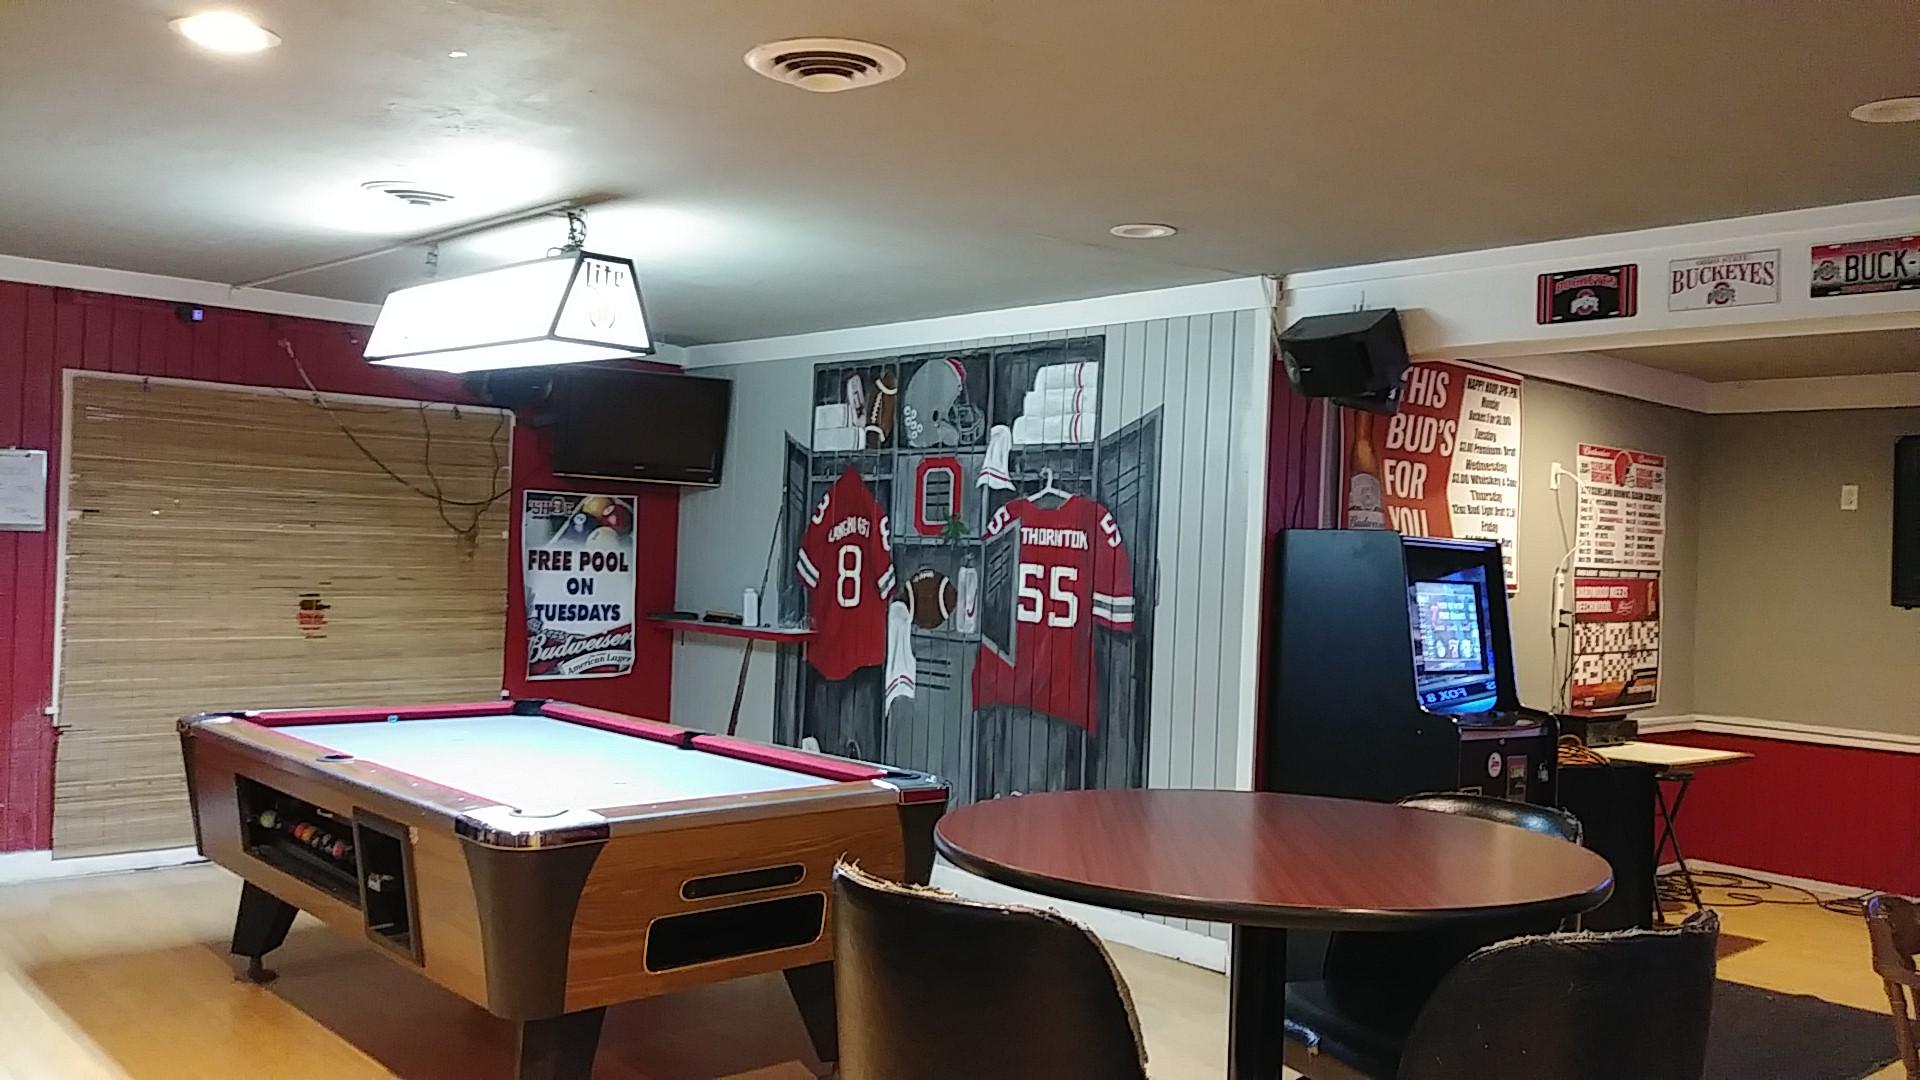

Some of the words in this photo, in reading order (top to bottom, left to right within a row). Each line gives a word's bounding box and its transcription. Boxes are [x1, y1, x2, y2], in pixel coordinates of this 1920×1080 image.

[1672, 261, 1774, 294] BUCKEYES
[1845, 248, 1920, 281] BUCK-
[1385, 412, 1456, 457] BUD'S
[1384, 459, 1427, 500] FOR
[1466, 459, 1508, 473] Wednesday
[1470, 490, 1503, 503] Thursday
[1388, 505, 1429, 538] YOU
[1020, 527, 1089, 550] THORNTON
[527, 549, 573, 571] FREE
[579, 551, 629, 573] POOL
[836, 545, 862, 608] 8
[566, 577, 594, 596] ON
[1017, 563, 1078, 628] 55
[534, 604, 621, 622] TUESDAYS
[528, 631, 632, 664] Budweiser
[568, 656, 605, 674] American
